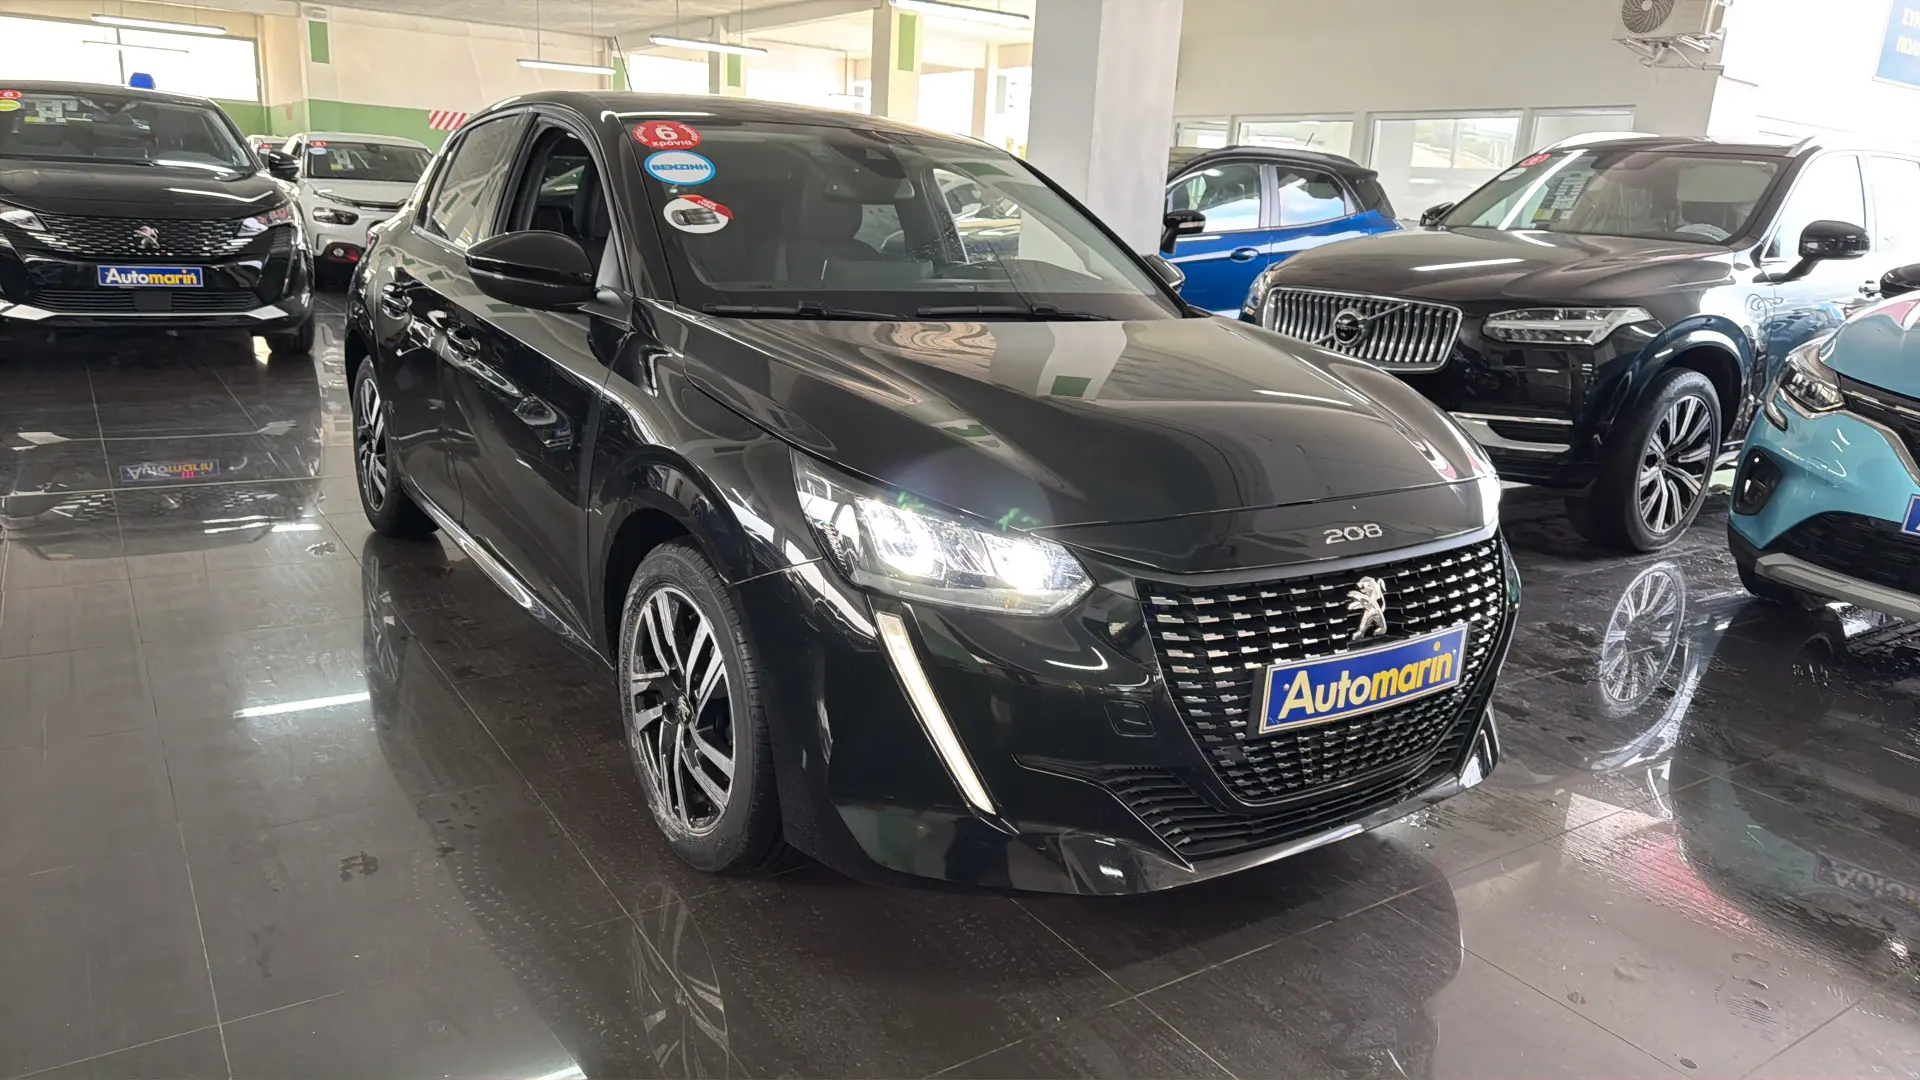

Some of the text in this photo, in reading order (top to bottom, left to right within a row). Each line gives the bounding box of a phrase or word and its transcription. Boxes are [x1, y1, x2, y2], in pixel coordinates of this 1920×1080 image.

[655, 127, 679, 141] 6
[105, 268, 198, 285] Automarin
[1323, 523, 1383, 545] 208
[1278, 641, 1453, 720] Automarin
